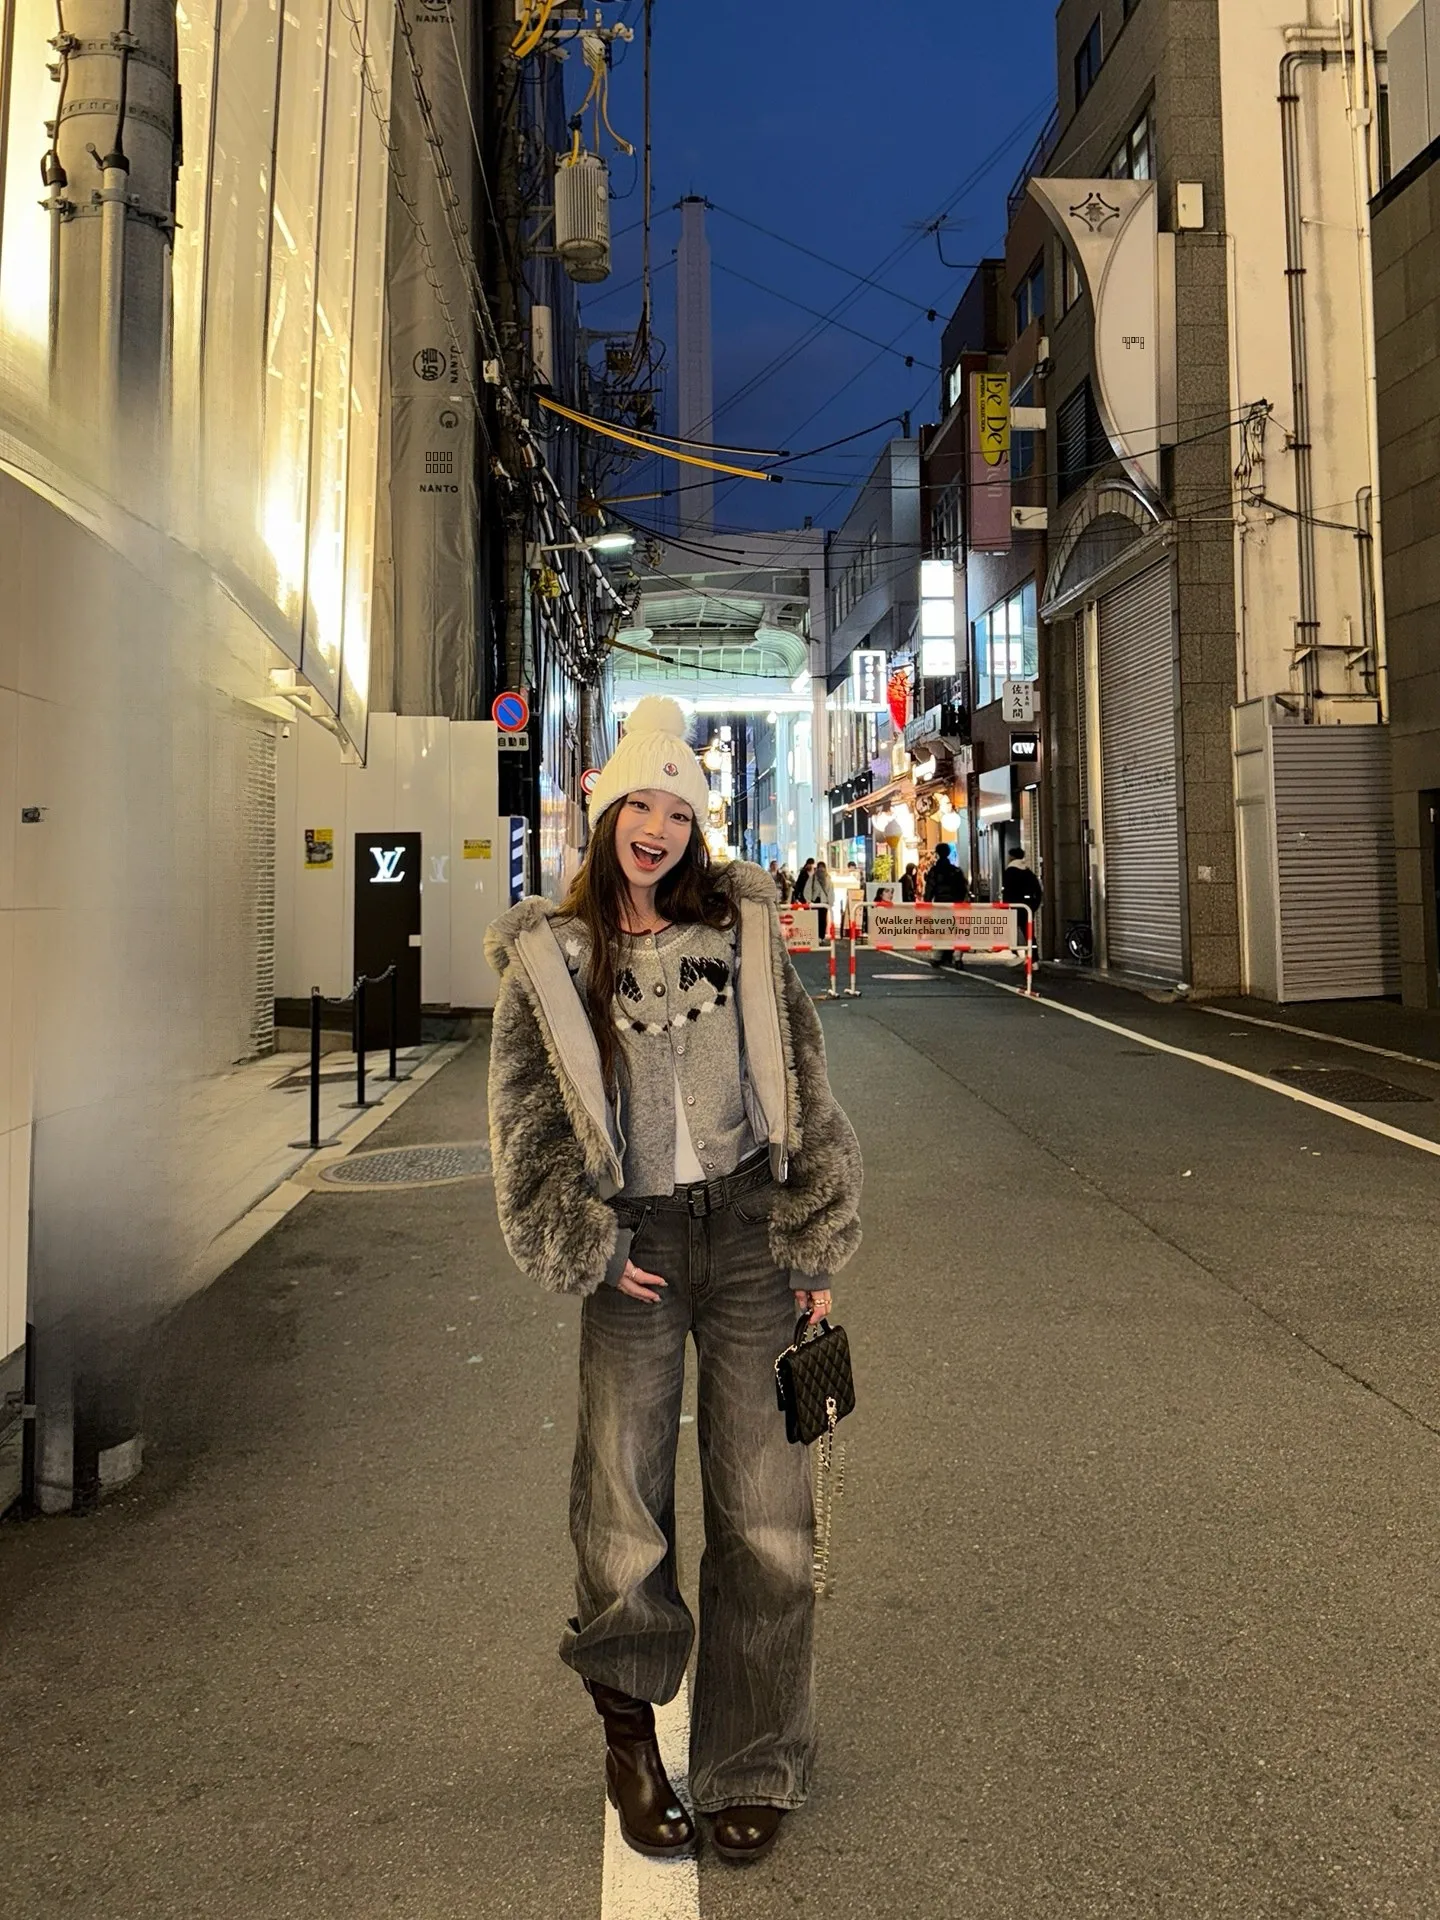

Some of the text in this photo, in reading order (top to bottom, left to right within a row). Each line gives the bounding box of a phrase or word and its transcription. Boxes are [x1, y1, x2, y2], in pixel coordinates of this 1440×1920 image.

[415, 14, 455, 24] NANTO
[419, 484, 459, 493] NANTO
[1012, 684, 1024, 719] 佐久間
[498, 737, 528, 747] 自動車
[369, 846, 406, 884] LV
[875, 916, 913, 926] (Walker
[915, 916, 956, 926] Heaven)
[948, 926, 971, 937] Ying
